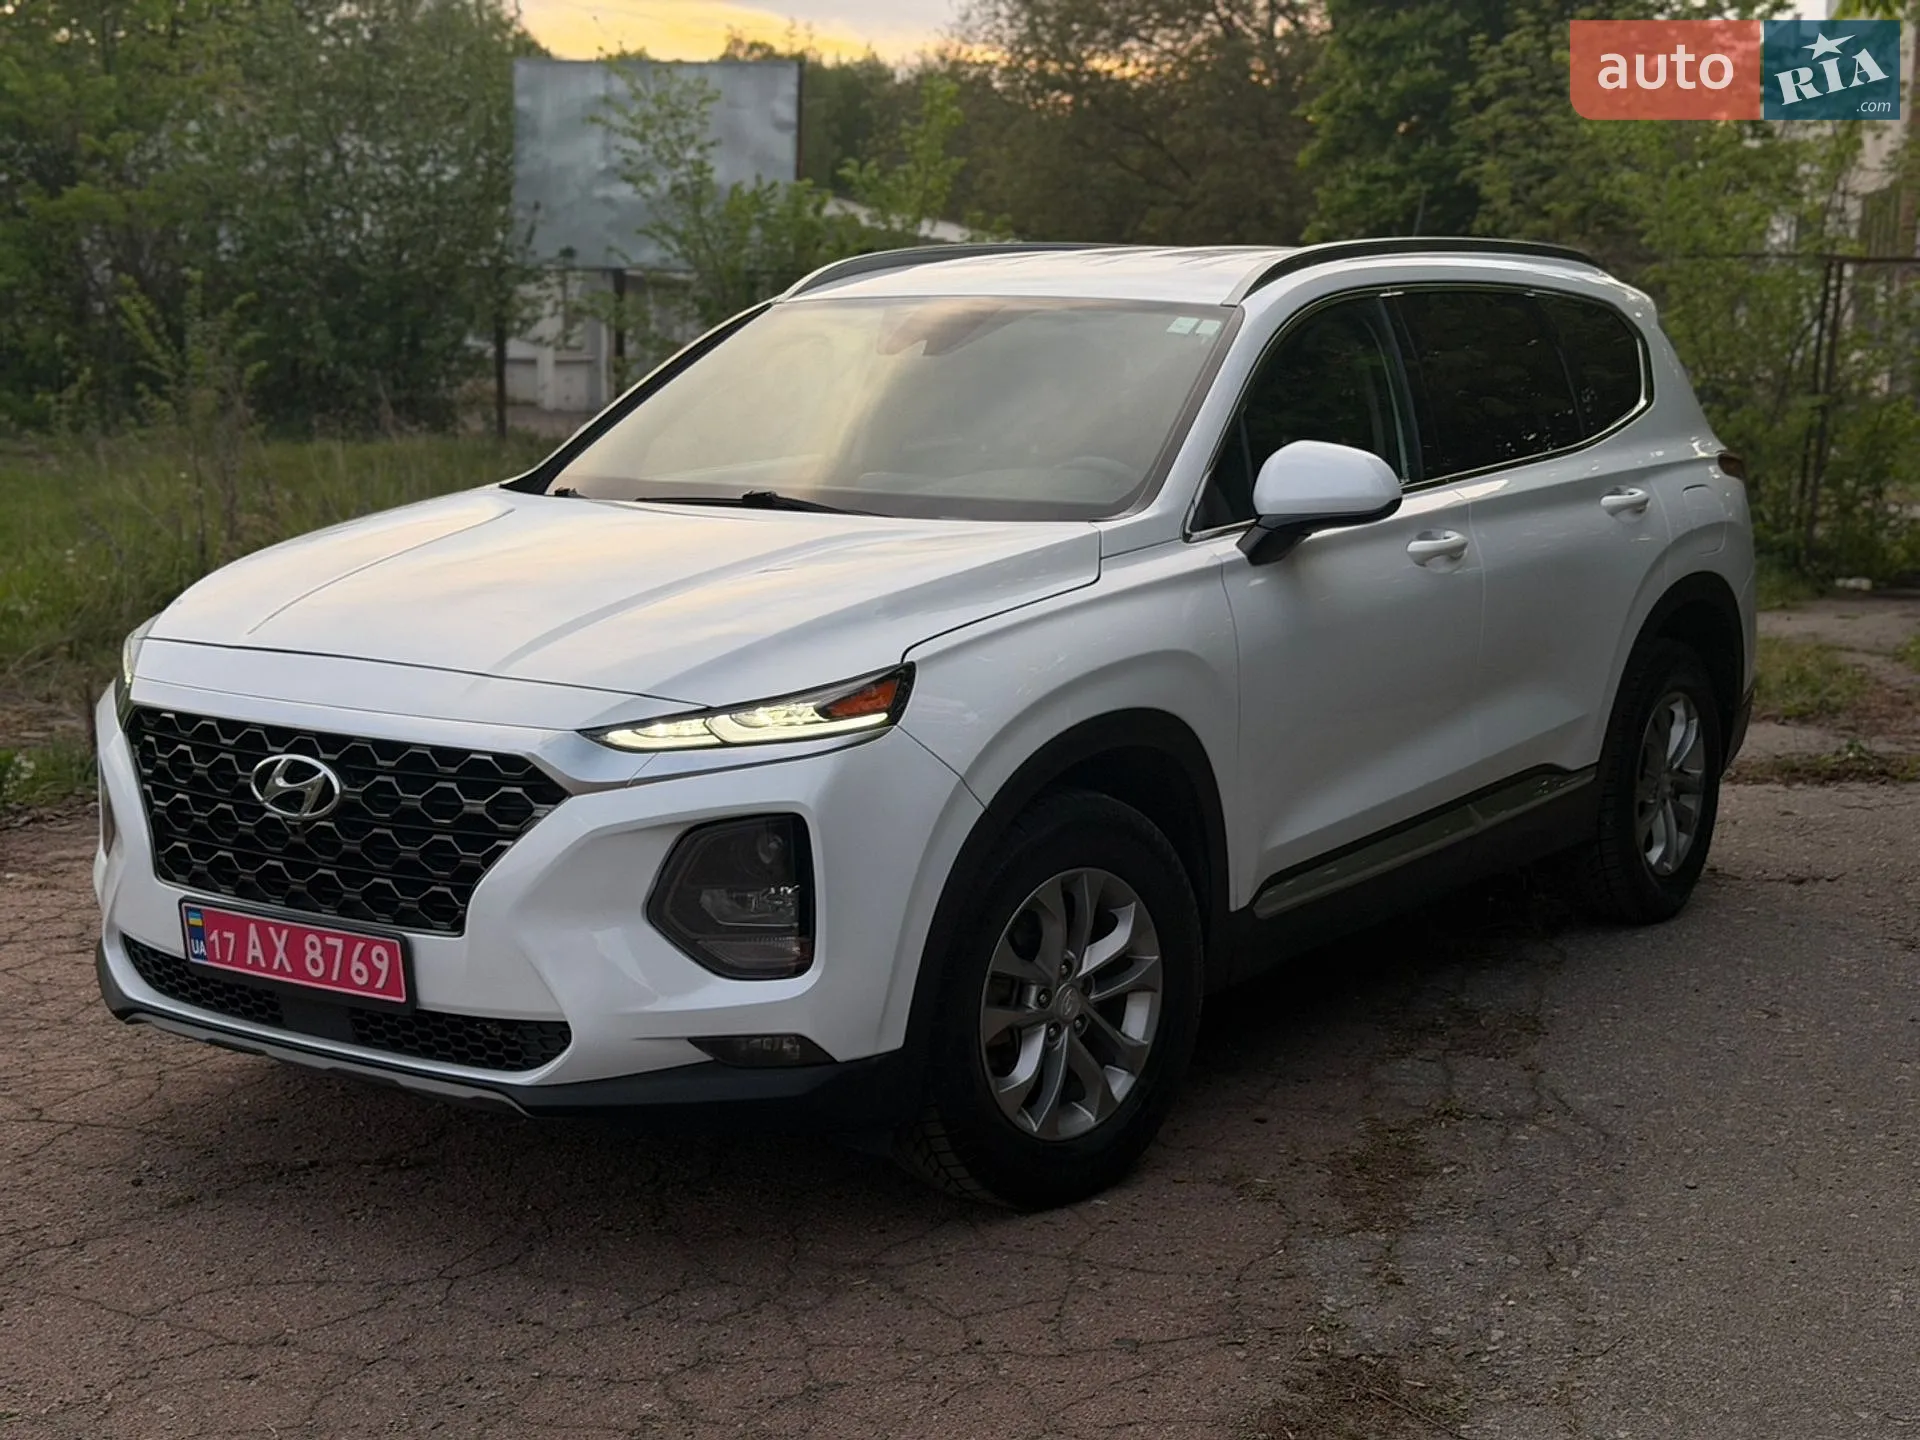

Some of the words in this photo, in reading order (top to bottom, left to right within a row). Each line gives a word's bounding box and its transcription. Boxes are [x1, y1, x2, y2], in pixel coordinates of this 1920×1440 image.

[190, 938, 207, 956] UA
[209, 929, 236, 963] 17
[246, 922, 293, 973] AX
[304, 933, 390, 989] 8769
